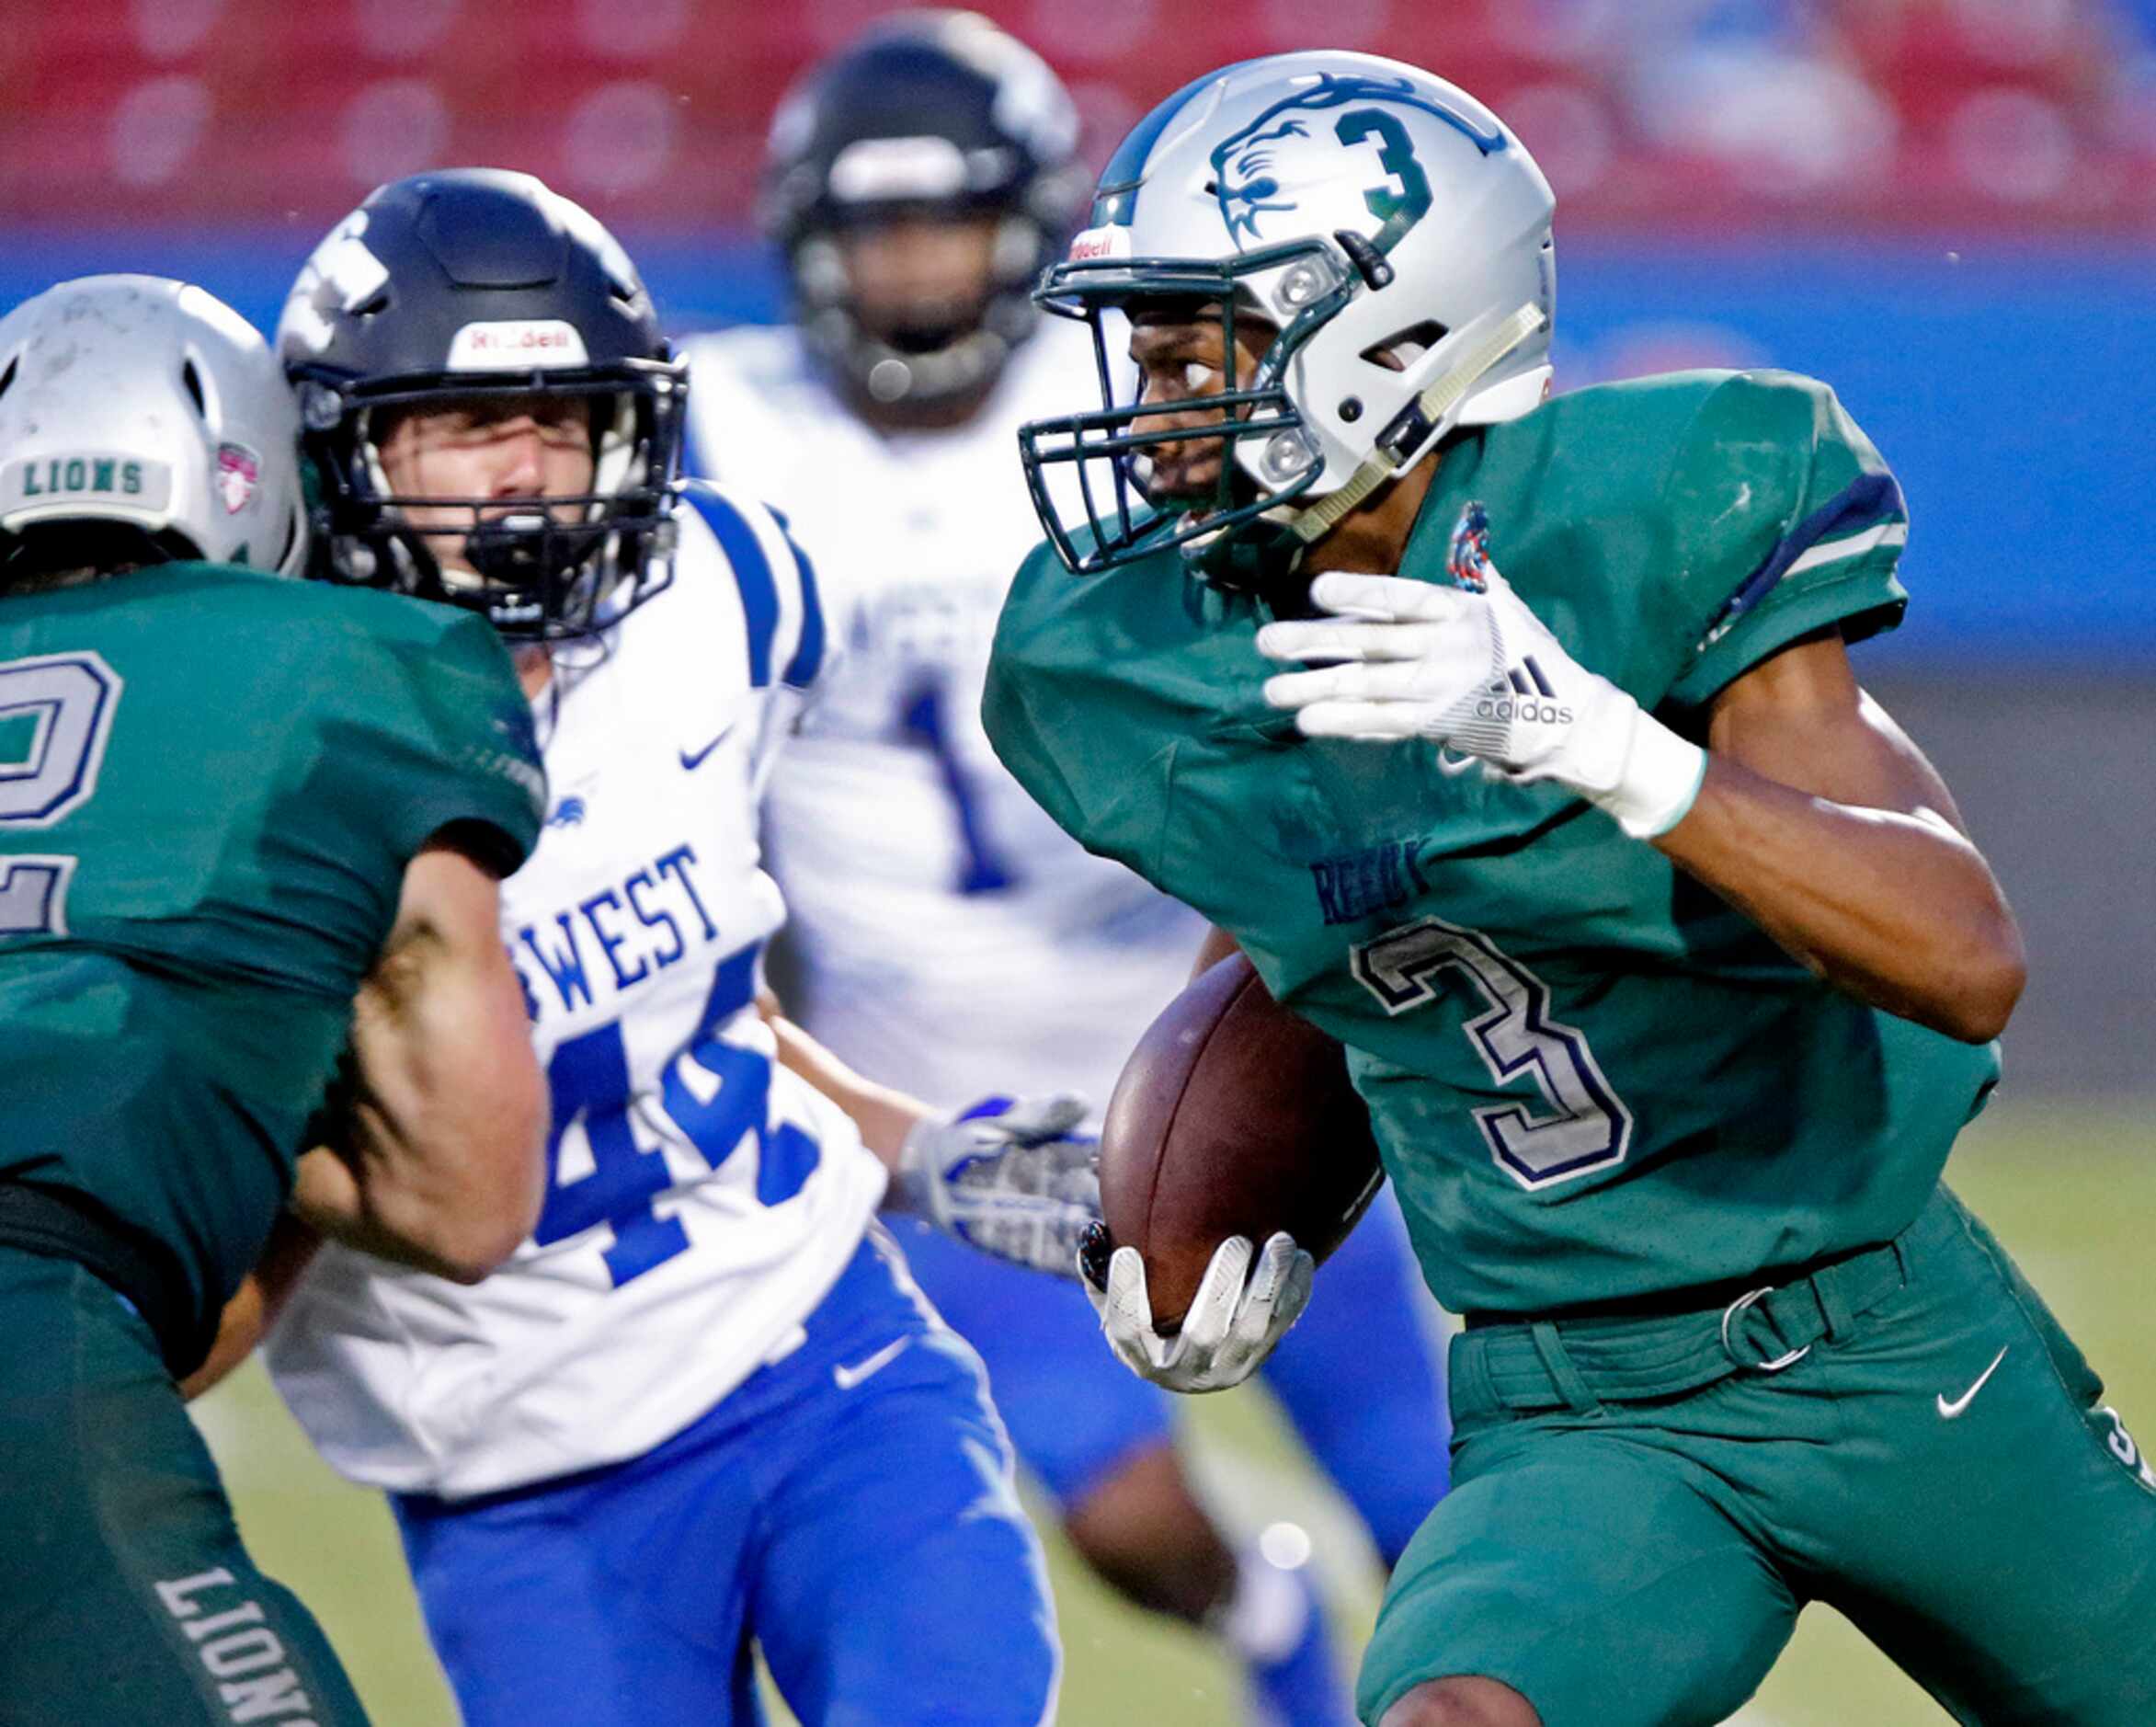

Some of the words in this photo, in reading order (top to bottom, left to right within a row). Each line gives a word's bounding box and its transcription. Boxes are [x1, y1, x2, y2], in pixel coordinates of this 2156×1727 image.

[1336, 107, 1434, 223] 3
[23, 457, 143, 497] LIONS
[1476, 694, 1575, 726] adidas
[519, 842, 719, 1012] WEST
[1350, 915, 1634, 1193] 3
[154, 1566, 321, 1727] LION
